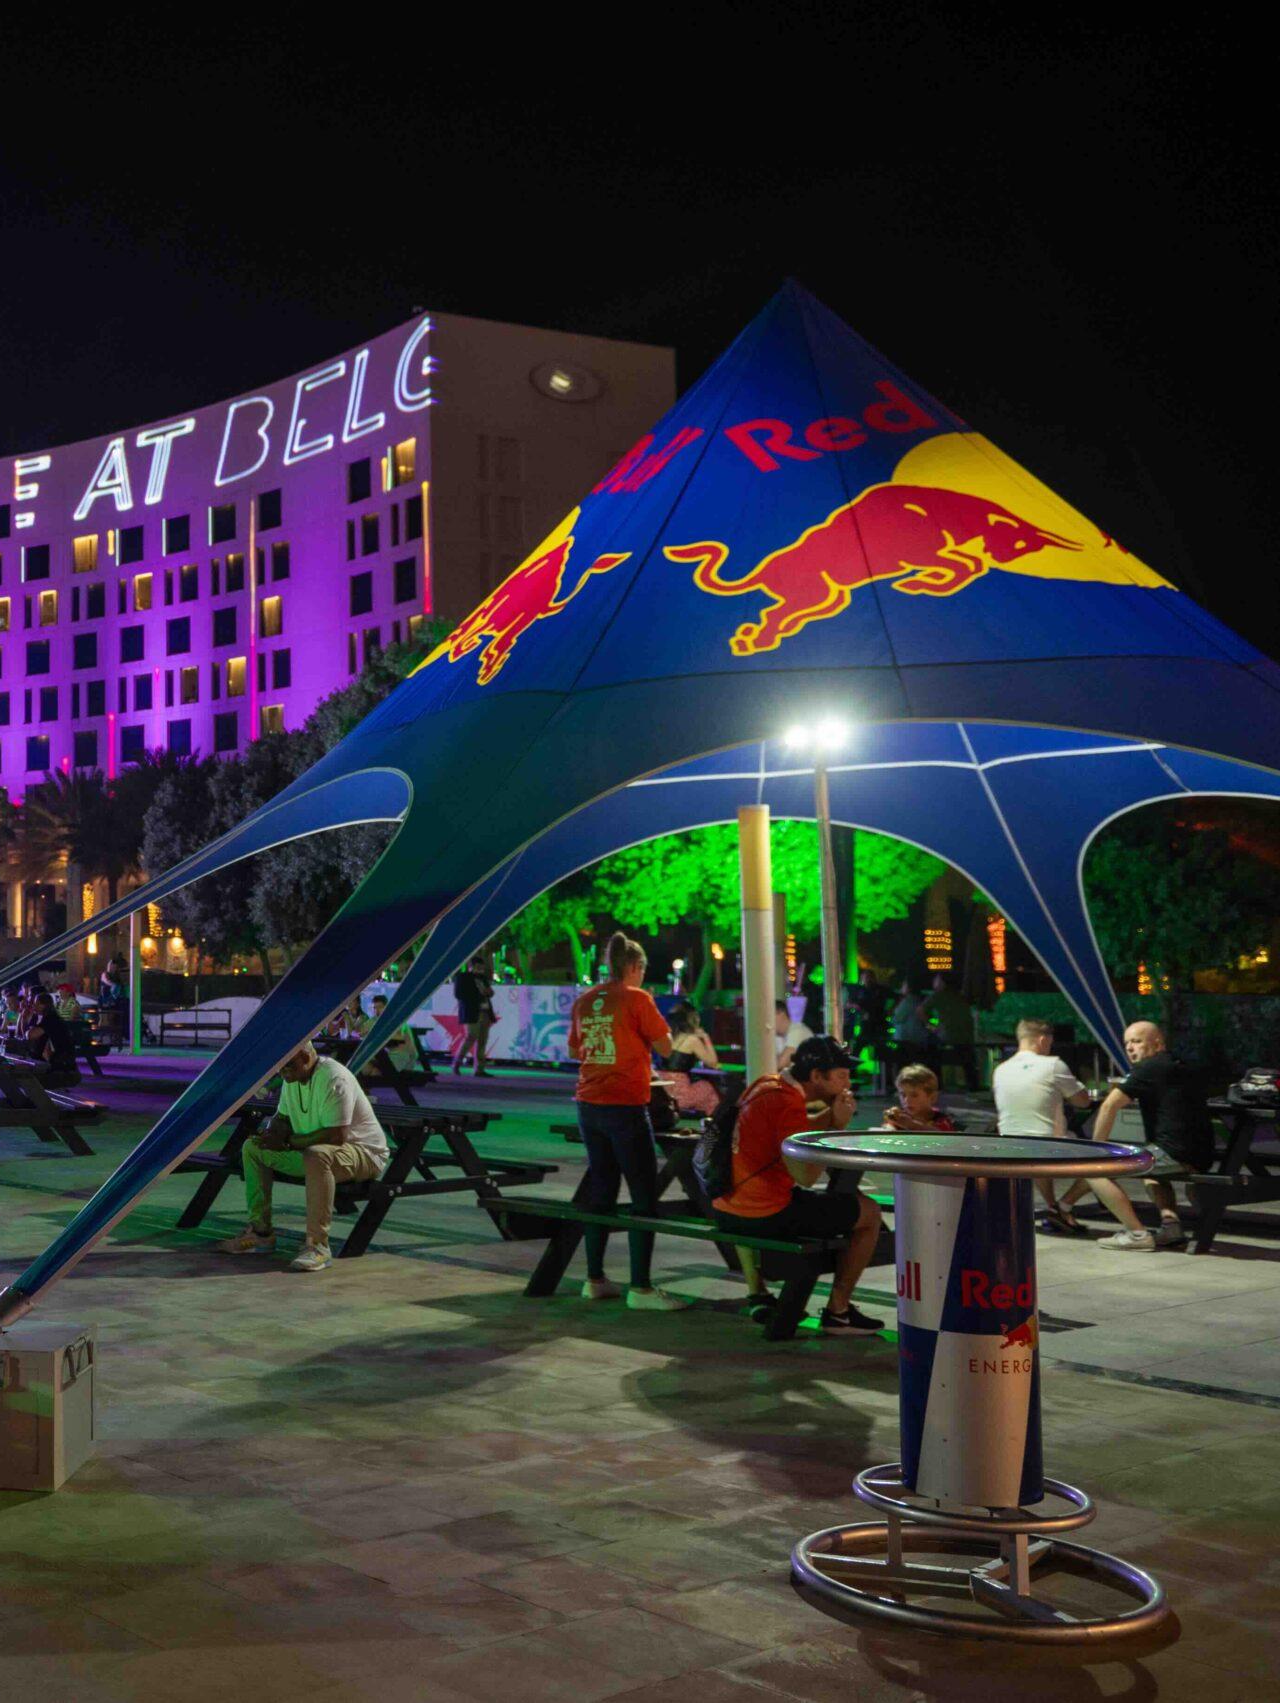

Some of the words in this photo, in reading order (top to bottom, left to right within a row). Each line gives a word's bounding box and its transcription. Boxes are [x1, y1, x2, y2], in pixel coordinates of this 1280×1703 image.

[724, 380, 940, 473] Red
[73, 417, 195, 521] AT
[961, 1267, 1034, 1309] Red
[970, 1358, 1031, 1375] ENERG
